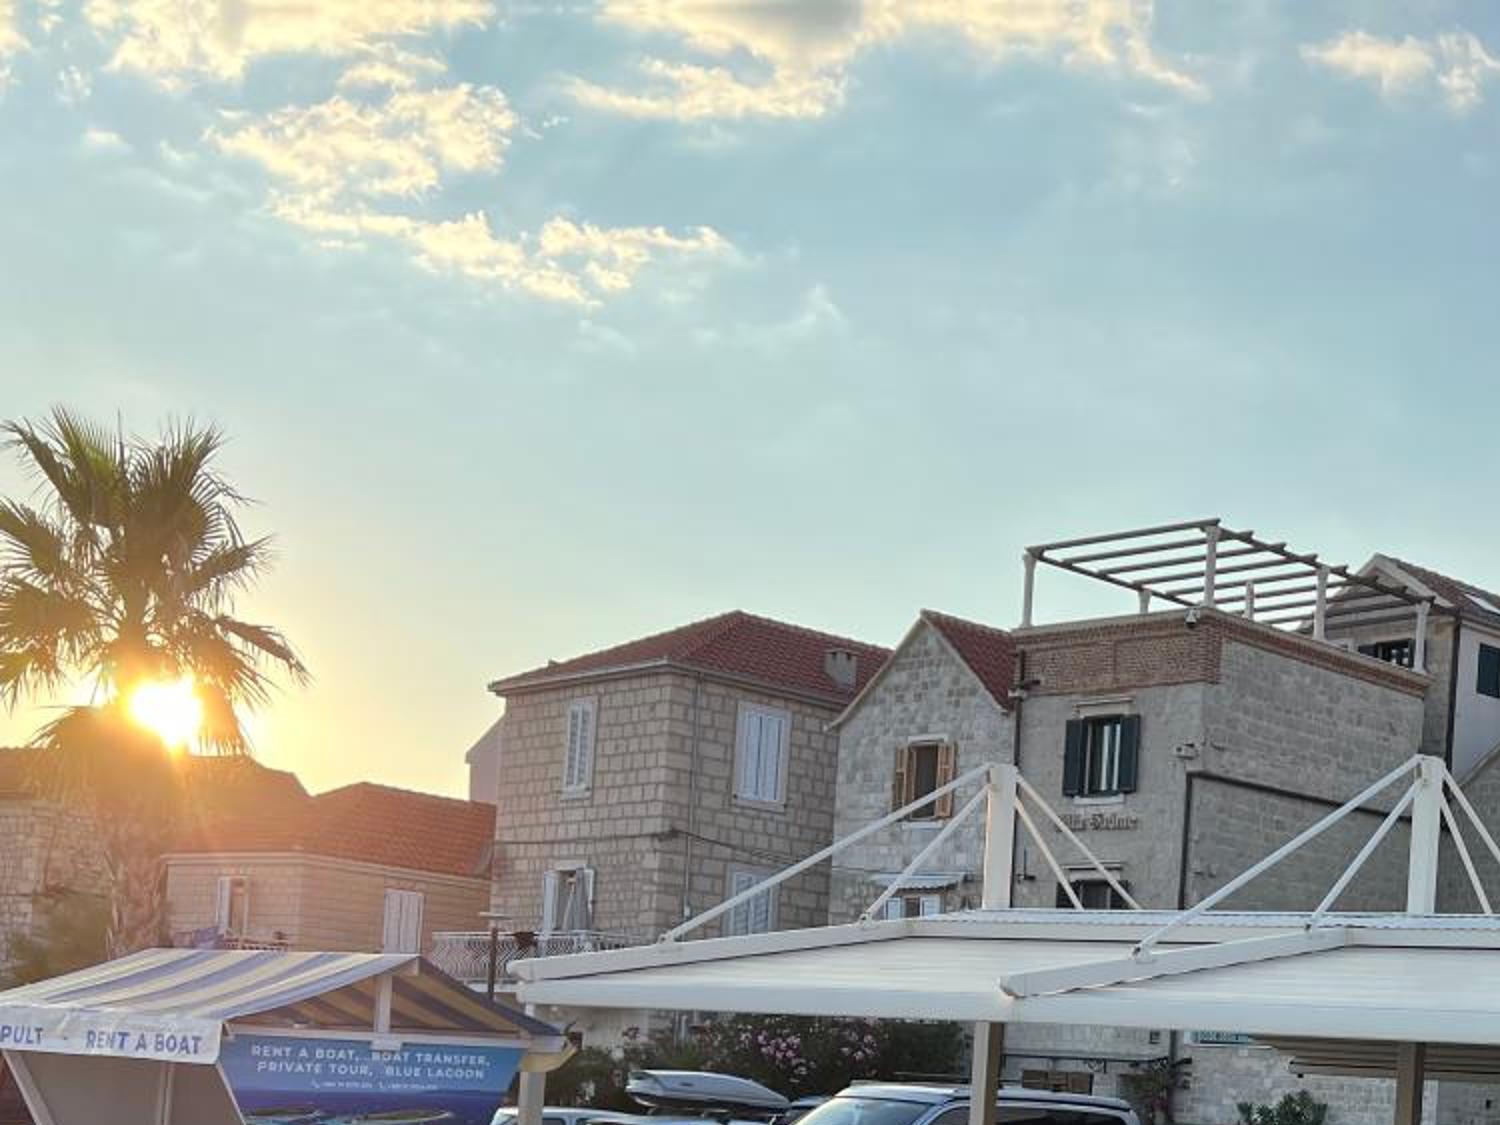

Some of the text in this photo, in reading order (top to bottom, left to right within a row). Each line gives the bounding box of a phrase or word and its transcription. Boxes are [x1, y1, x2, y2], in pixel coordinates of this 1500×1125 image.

[0, 1025, 203, 1055] PULT RENT A BOAT
[251, 1045, 291, 1058] RENT
[298, 1047, 309, 1059] A
[371, 1050, 409, 1063] BOAT
[256, 1061, 321, 1075] PRIVATE
[385, 1065, 421, 1078] BLUE
[427, 1066, 484, 1080] LAGOON
